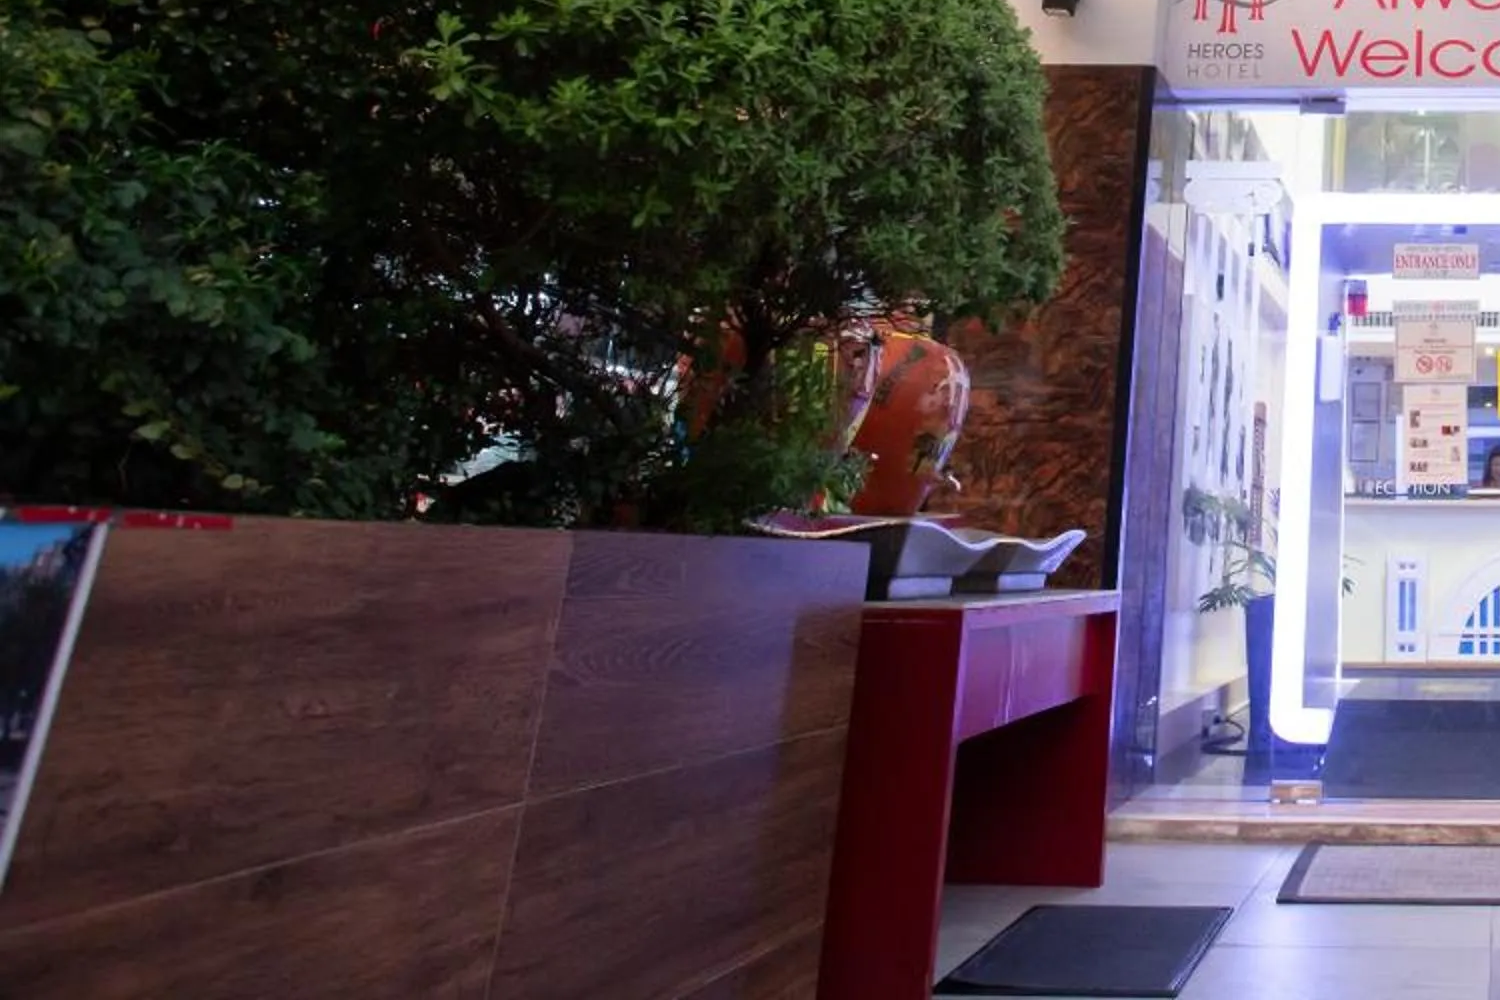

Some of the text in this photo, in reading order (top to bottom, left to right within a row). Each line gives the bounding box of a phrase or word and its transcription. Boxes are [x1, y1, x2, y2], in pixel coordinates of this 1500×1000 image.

[1188, 43, 1265, 60] HEROES
[1187, 62, 1262, 79] HOTEL
[1366, 480, 1452, 496] ECTION
